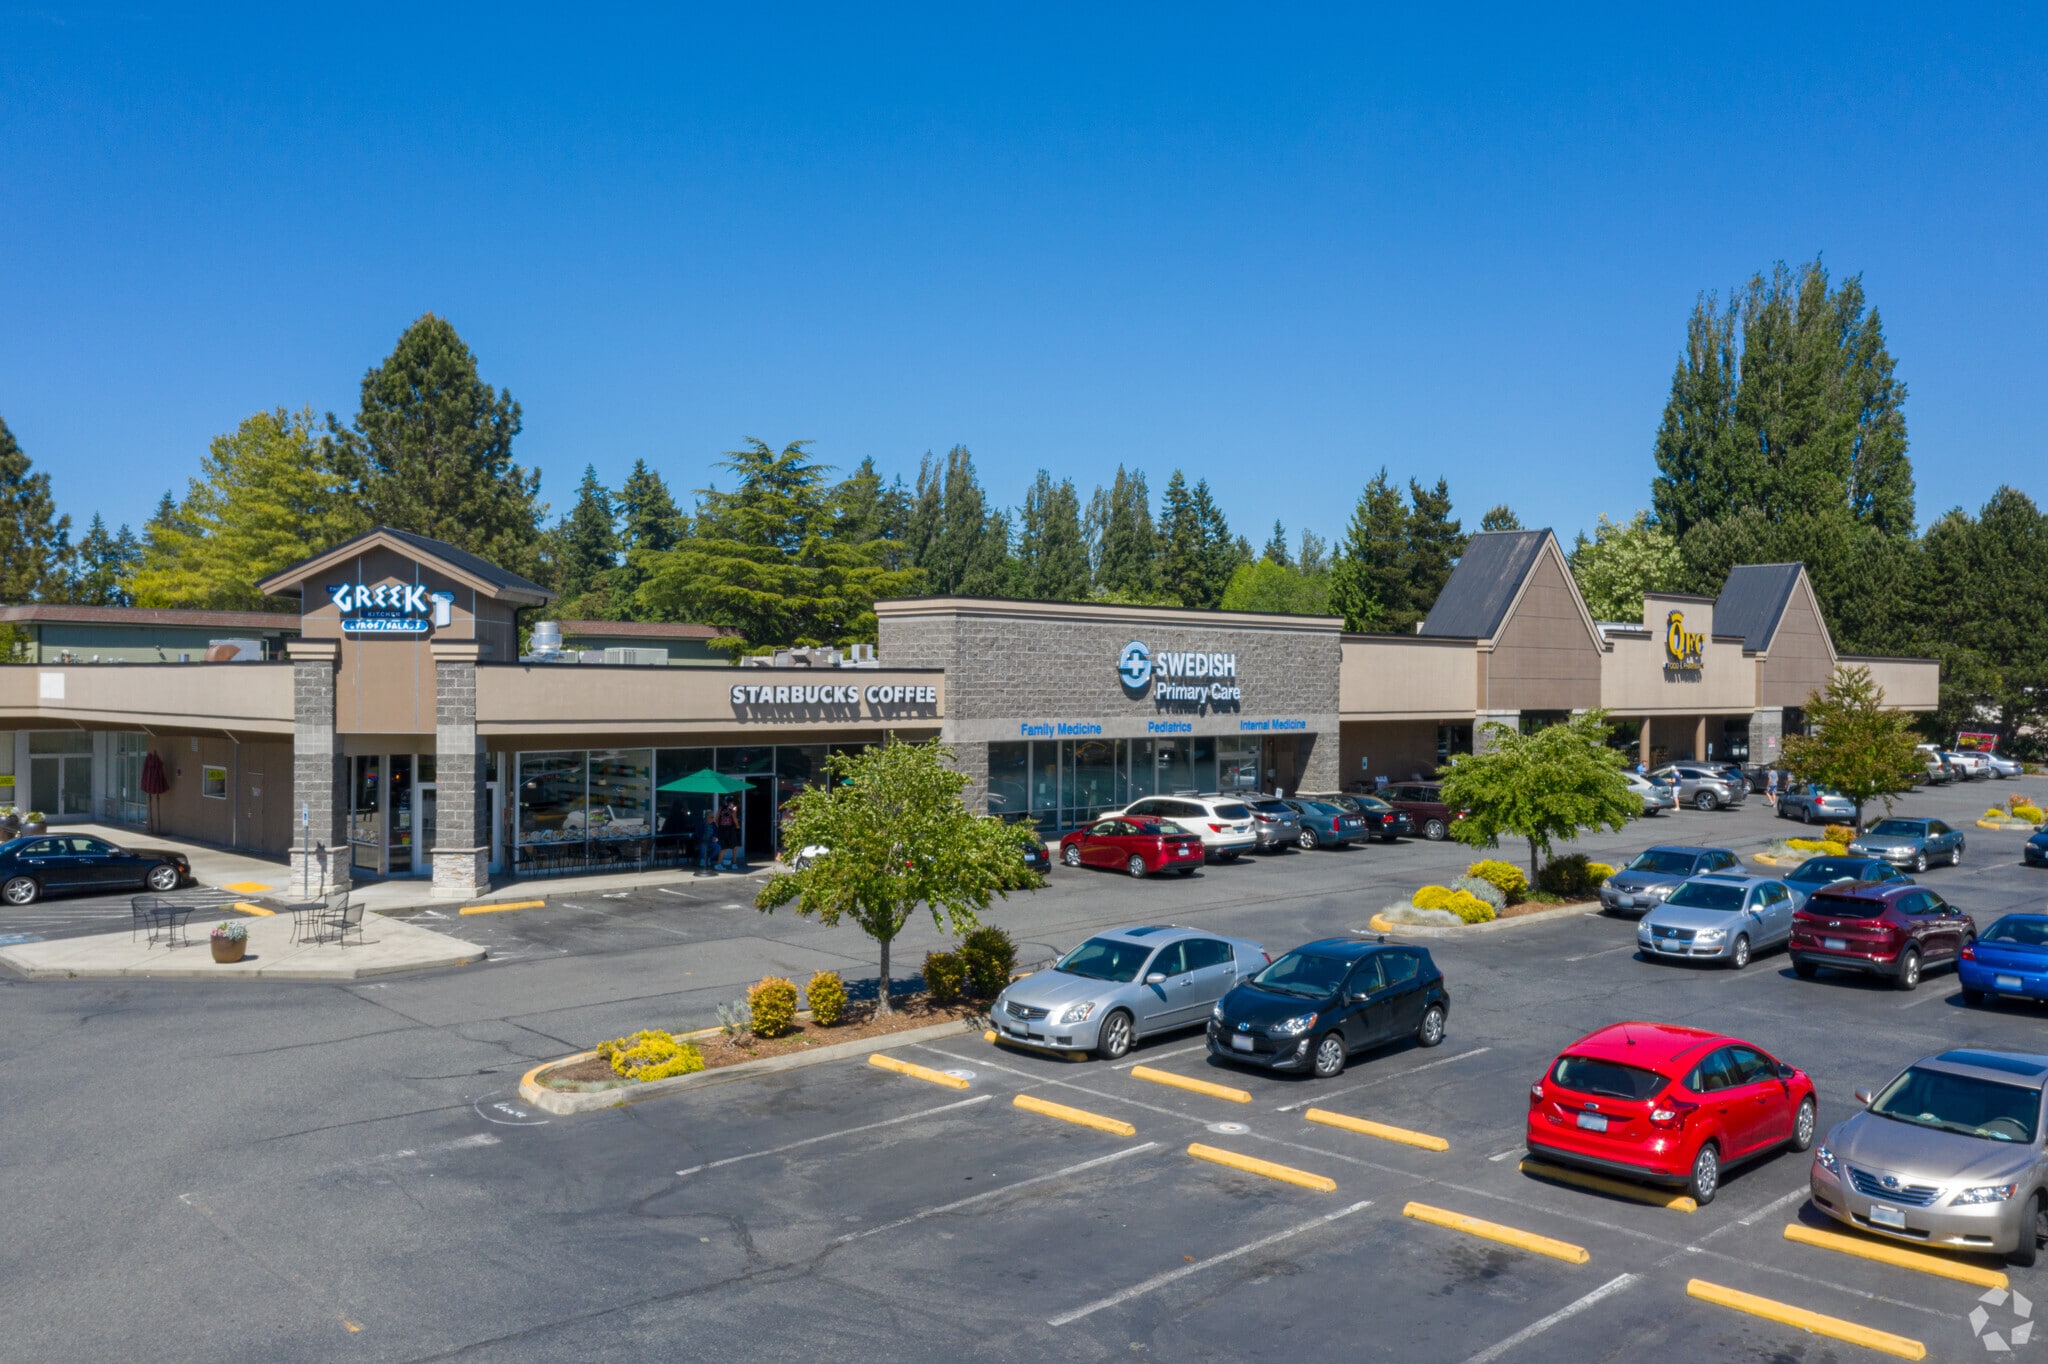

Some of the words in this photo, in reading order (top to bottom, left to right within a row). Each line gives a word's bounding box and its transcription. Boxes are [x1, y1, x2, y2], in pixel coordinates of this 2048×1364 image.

[332, 582, 428, 612] GREEK
[1668, 620, 1706, 661] QFC
[1155, 651, 1236, 677] SWEDISH
[731, 685, 859, 704] STARBUCKS
[865, 685, 937, 704] COFFEE
[1156, 682, 1208, 703] Primary
[1211, 682, 1240, 700] Care
[1020, 722, 1055, 738] Family
[1057, 722, 1102, 735] Medicine
[1148, 720, 1192, 733] Pediatrics
[1240, 719, 1270, 732] Internal
[1272, 718, 1306, 730] Medicine
